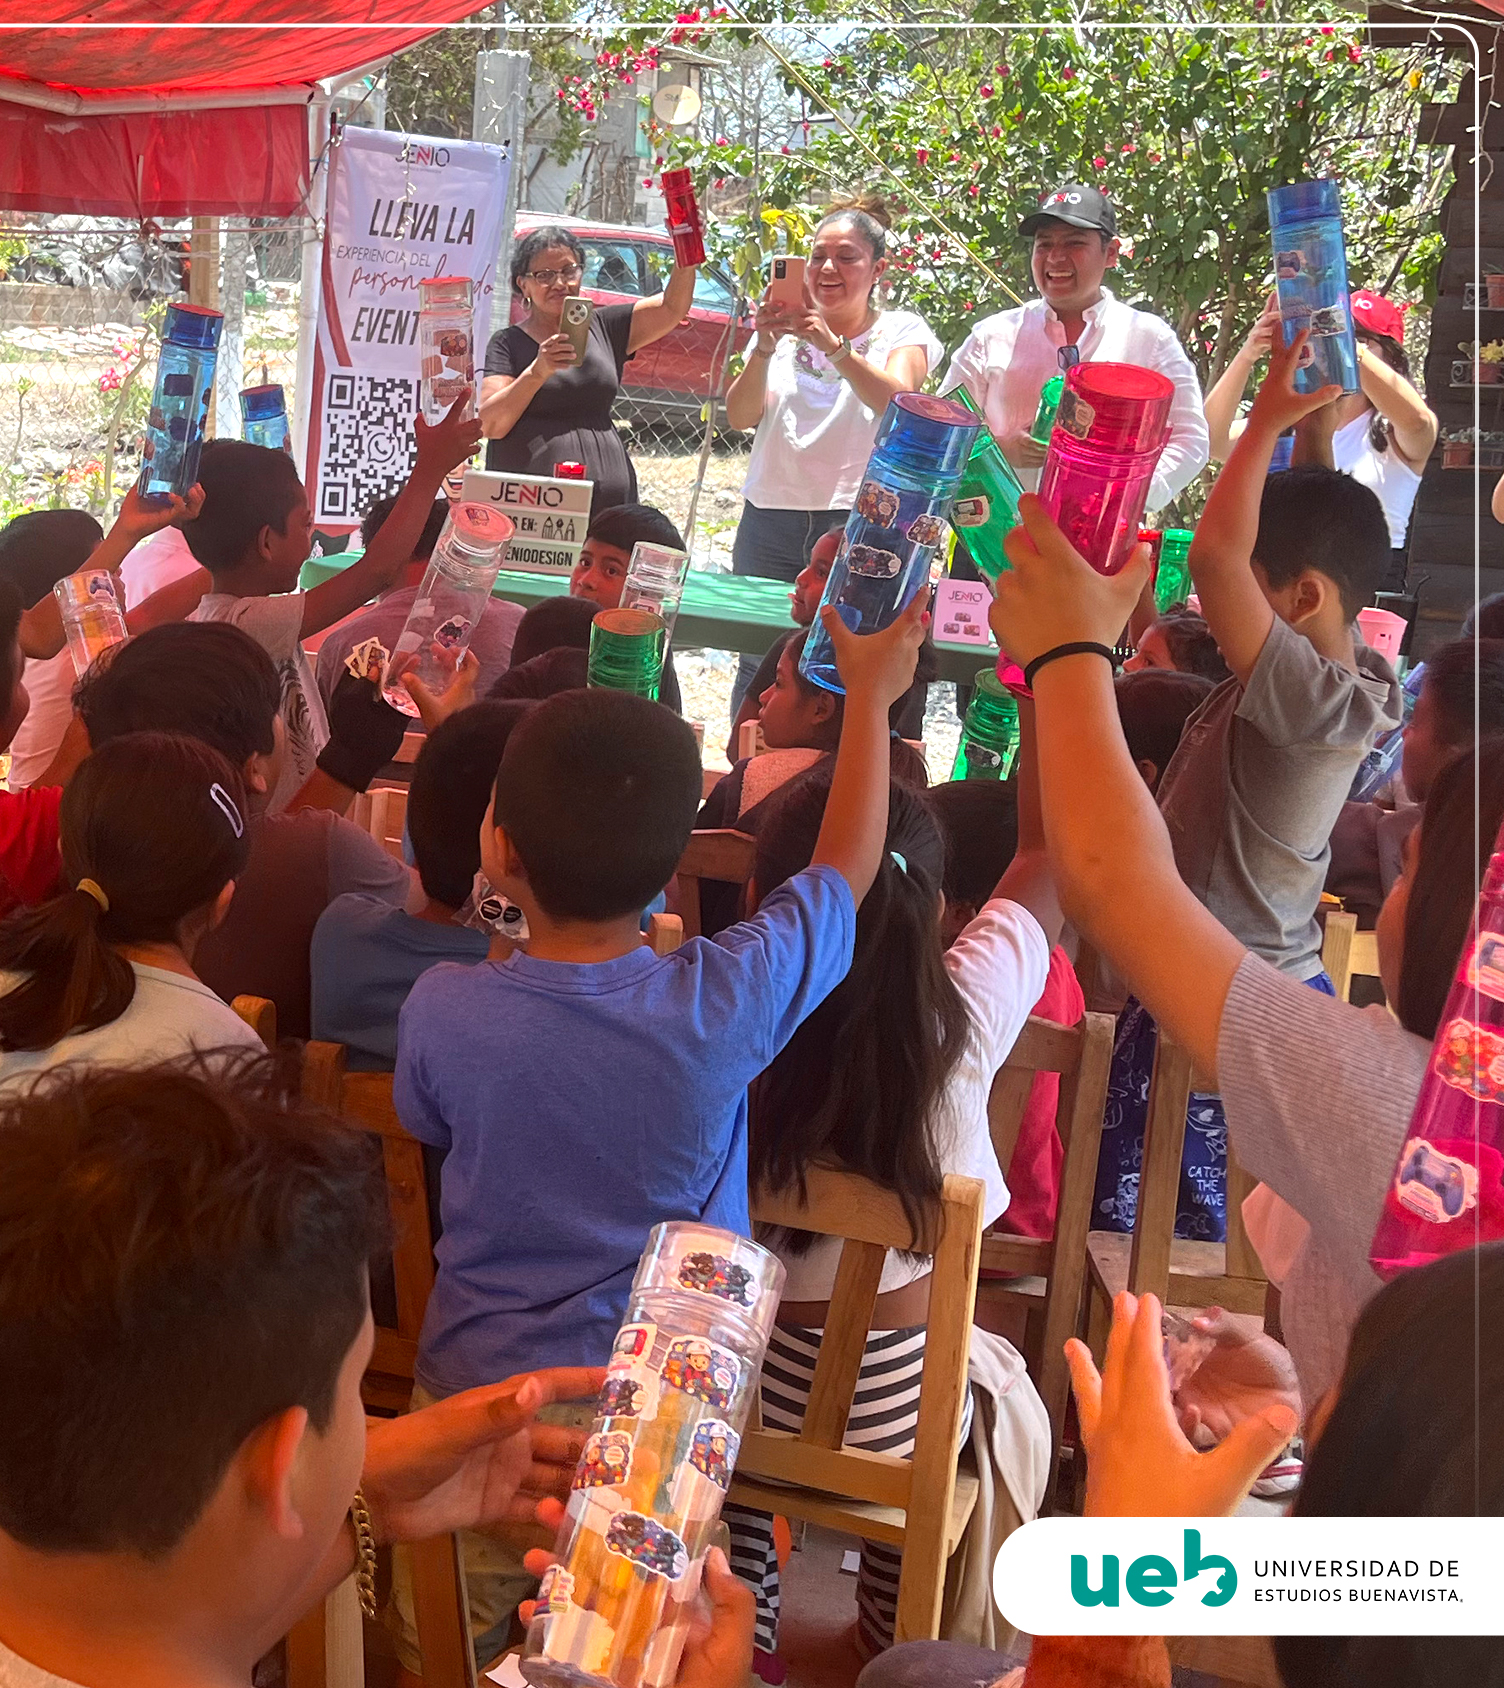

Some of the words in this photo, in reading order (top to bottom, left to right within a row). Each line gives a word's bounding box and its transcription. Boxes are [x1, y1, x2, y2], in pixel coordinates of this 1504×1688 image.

[395, 144, 450, 167] JENIO
[368, 198, 440, 243] LLEVA
[444, 206, 475, 245] LA
[336, 244, 407, 266] EXPERIENCIA
[409, 252, 431, 268] DEL
[350, 306, 421, 346] EVENT
[490, 481, 563, 507] JENIO
[521, 517, 538, 532] EN:
[504, 546, 573, 567] ENIODESIGN
[948, 591, 983, 602] JENIO
[1188, 1165, 1227, 1179] CATCH
[1196, 1179, 1219, 1193] THE
[1191, 1192, 1225, 1206] WAVE
